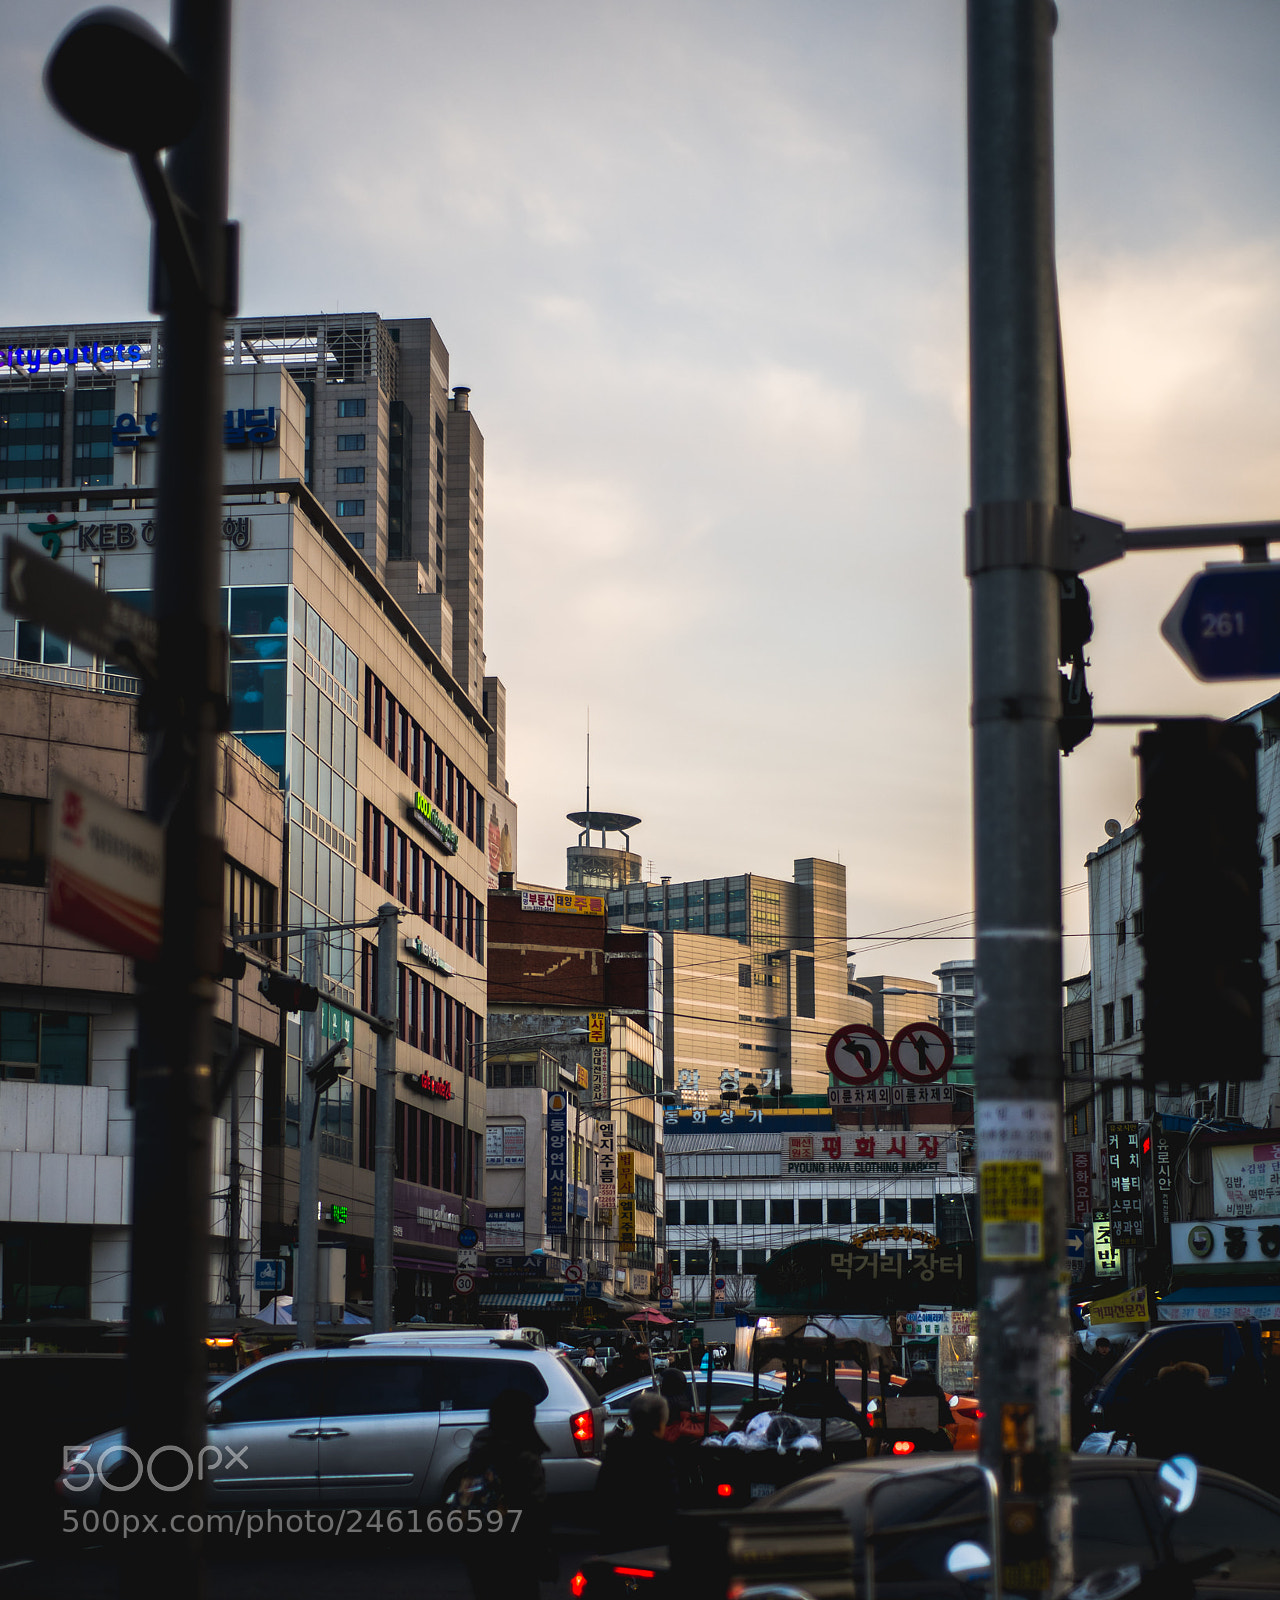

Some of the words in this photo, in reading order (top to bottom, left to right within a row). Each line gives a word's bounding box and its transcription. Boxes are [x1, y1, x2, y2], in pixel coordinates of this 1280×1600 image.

[48, 341, 141, 366] outlets
[78, 523, 137, 551] KEB
[1201, 612, 1244, 638] 261
[529, 893, 554, 907] 부동산
[556, 896, 572, 906] 태양
[574, 897, 603, 912] 주름
[591, 1020, 604, 1042] 사주
[830, 1089, 890, 1104] 이륜차제외
[894, 1086, 953, 1103] 이륜차제외
[664, 1109, 764, 1125] 동화상가
[821, 1136, 939, 1160] 평화시장
[1108, 1134, 1139, 1149] 커피
[550, 1119, 565, 1183] 동양연사
[599, 1123, 615, 1183] 엘지주름
[788, 1162, 825, 1173] PYOUNG
[828, 1162, 851, 1173] HWA
[854, 1162, 899, 1173] CLOTHING
[902, 1161, 940, 1172] MARKET
[1109, 1153, 1139, 1169] 더치
[1156, 1138, 1172, 1191] 유로시안
[620, 1153, 633, 1193] 법무사
[1074, 1154, 1090, 1213] 중화요리
[1111, 1176, 1140, 1192] 버블티
[1112, 1199, 1142, 1214] 스무디
[620, 1201, 634, 1243] 엘지주름
[1112, 1220, 1143, 1237] 생과일
[830, 1252, 903, 1280] 먹거리
[912, 1253, 963, 1282] 장터
[458, 1278, 472, 1289] 30
[662, 1287, 671, 1296] 30
[1092, 1303, 1146, 1319] 커피전문점
